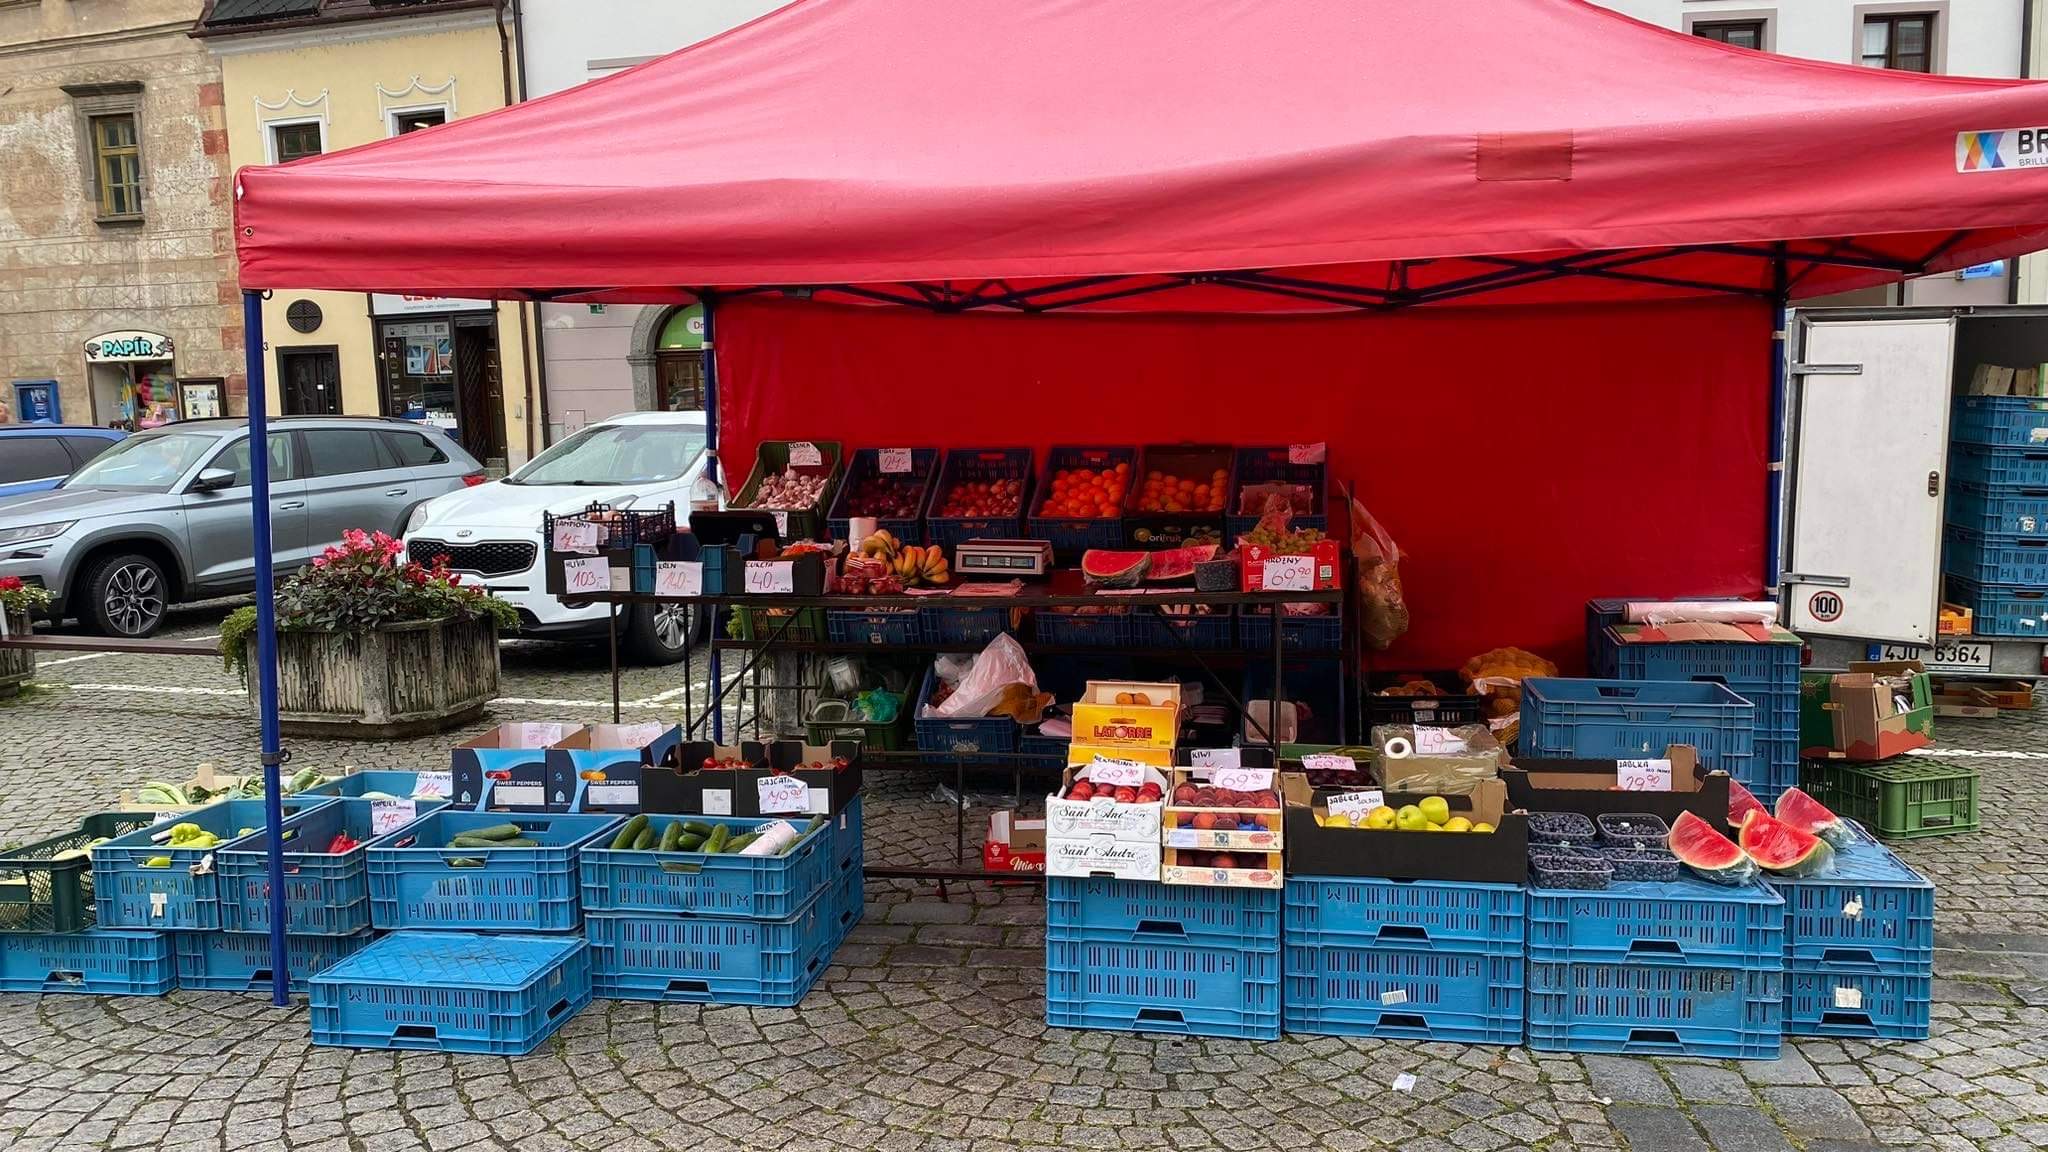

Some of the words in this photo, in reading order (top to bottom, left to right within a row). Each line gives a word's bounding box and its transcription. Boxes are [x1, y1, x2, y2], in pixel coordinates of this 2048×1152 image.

[2018, 157, 2048, 167] BRILL
[102, 336, 153, 357] PAPÍR
[1815, 596, 1838, 614] 100
[1934, 645, 1982, 663] 6364
[1192, 751, 1211, 759] KIWI
